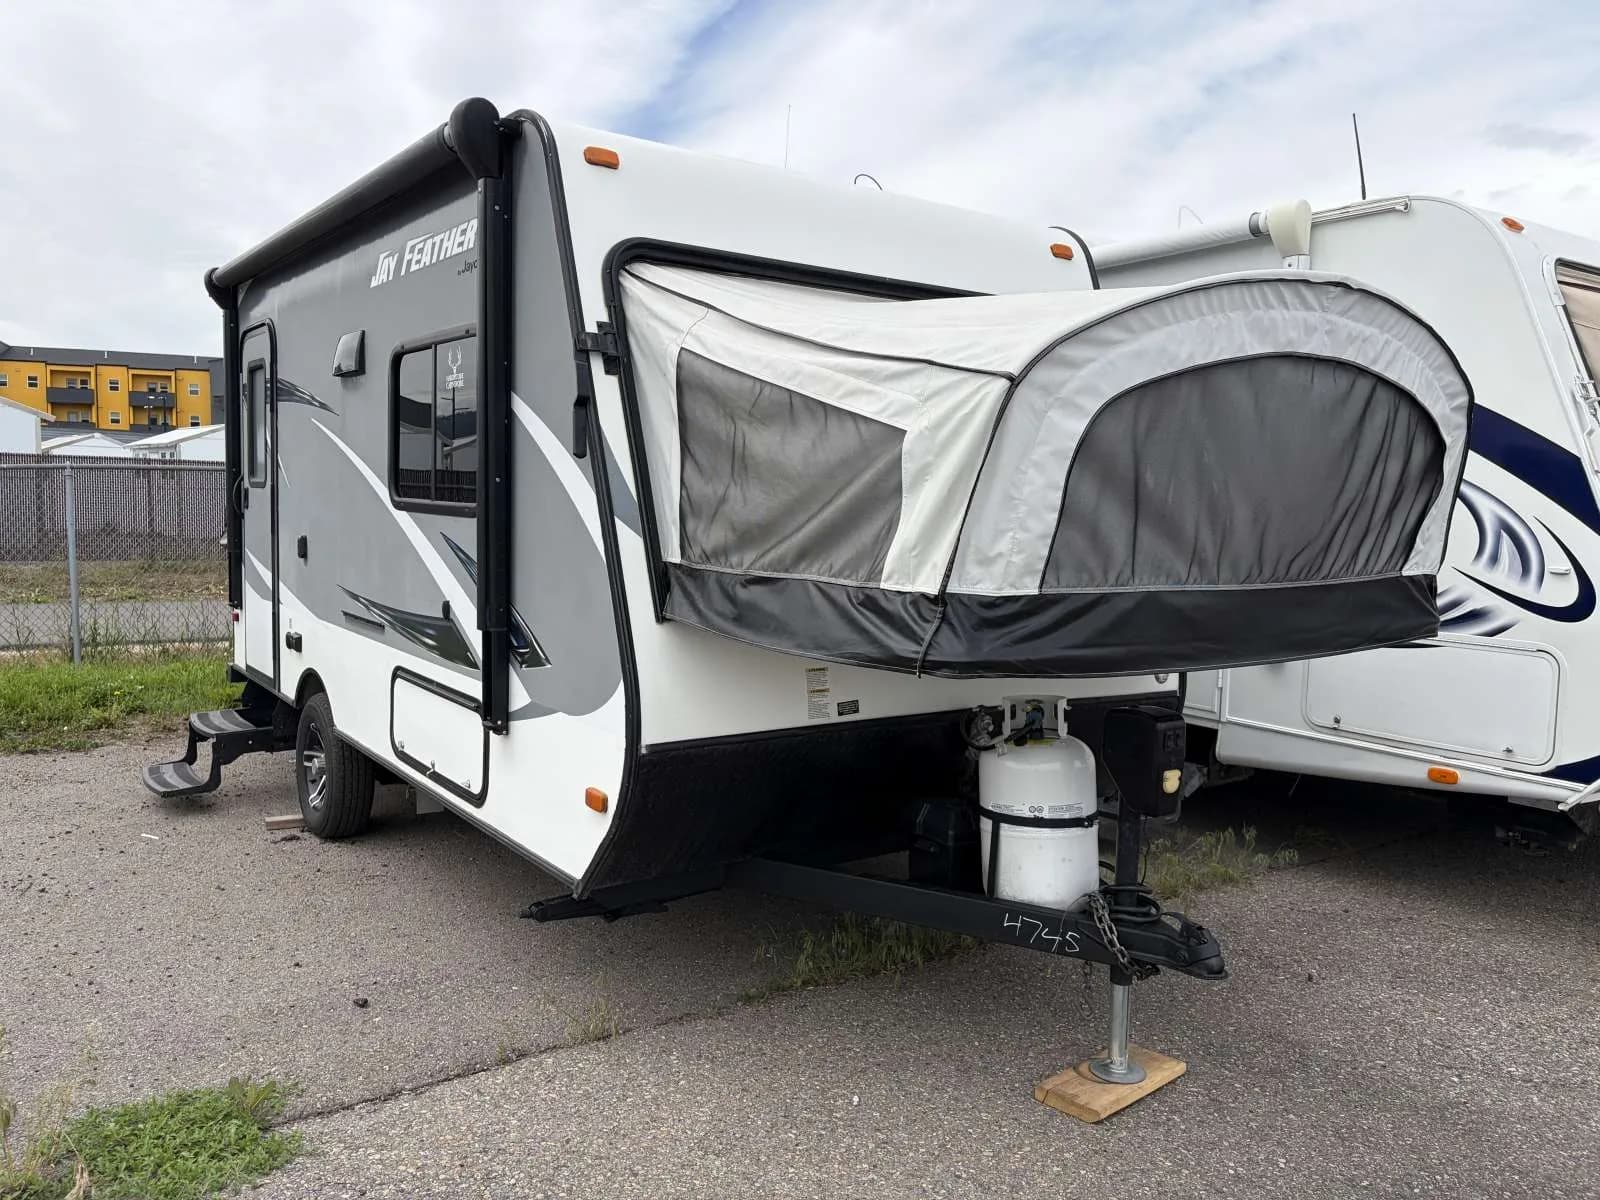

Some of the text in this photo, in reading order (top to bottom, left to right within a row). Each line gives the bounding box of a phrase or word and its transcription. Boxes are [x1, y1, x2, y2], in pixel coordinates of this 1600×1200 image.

[370, 218, 478, 288] JAY FEATHER
[462, 259, 478, 274] Jayc
[1003, 913, 1081, 953] 4745
